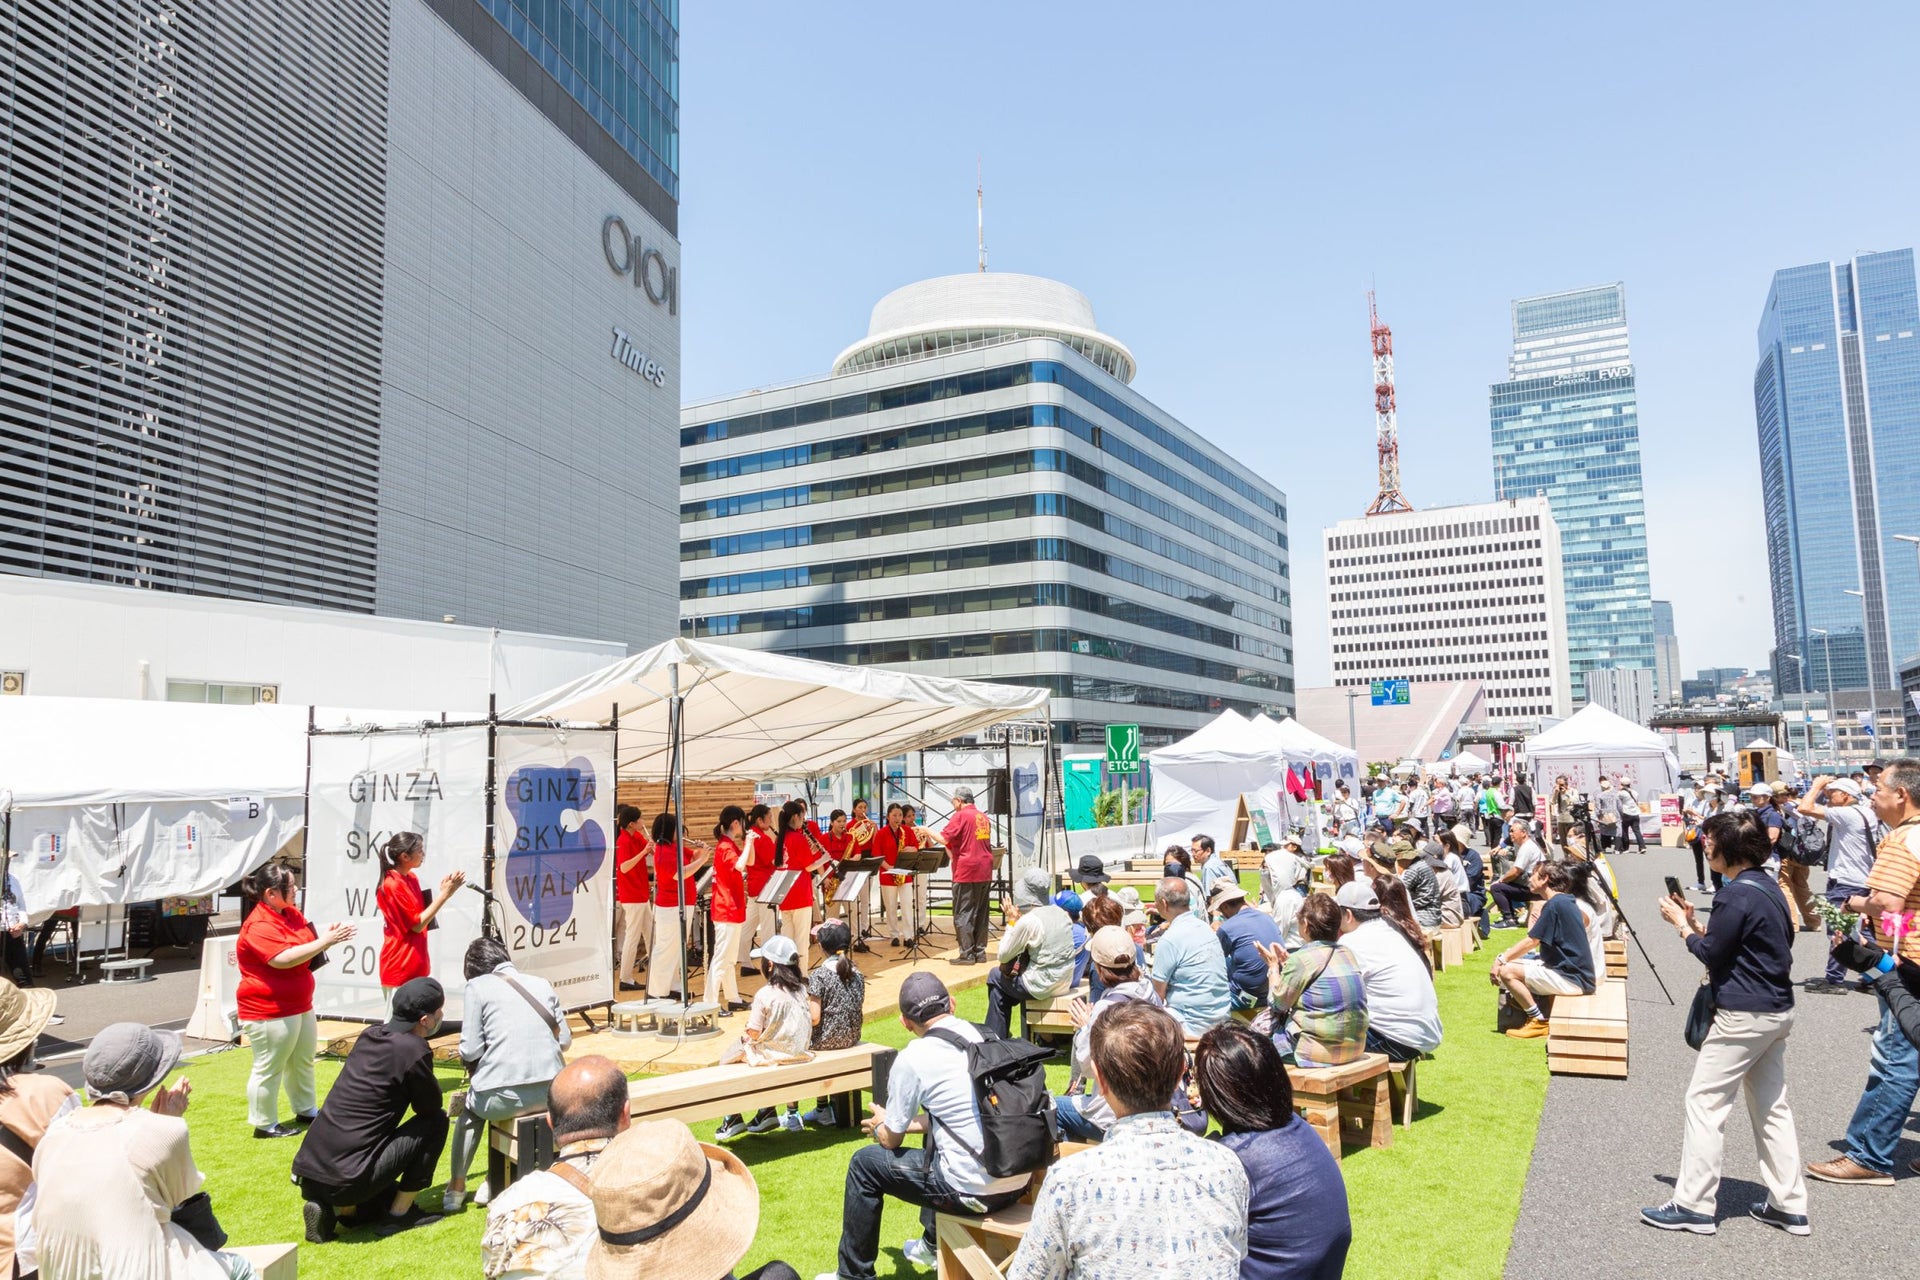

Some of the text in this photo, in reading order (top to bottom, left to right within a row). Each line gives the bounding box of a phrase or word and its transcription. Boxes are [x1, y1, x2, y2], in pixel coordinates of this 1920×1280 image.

[612, 326, 666, 389] Times
[1109, 760, 1138, 771] ETC車
[348, 771, 444, 803] GINZA
[516, 777, 597, 803] GINZA
[248, 802, 259, 819] B
[346, 830, 394, 861] SK
[515, 824, 569, 851] SKY
[515, 869, 590, 901] WALK
[513, 917, 578, 951] 2024
